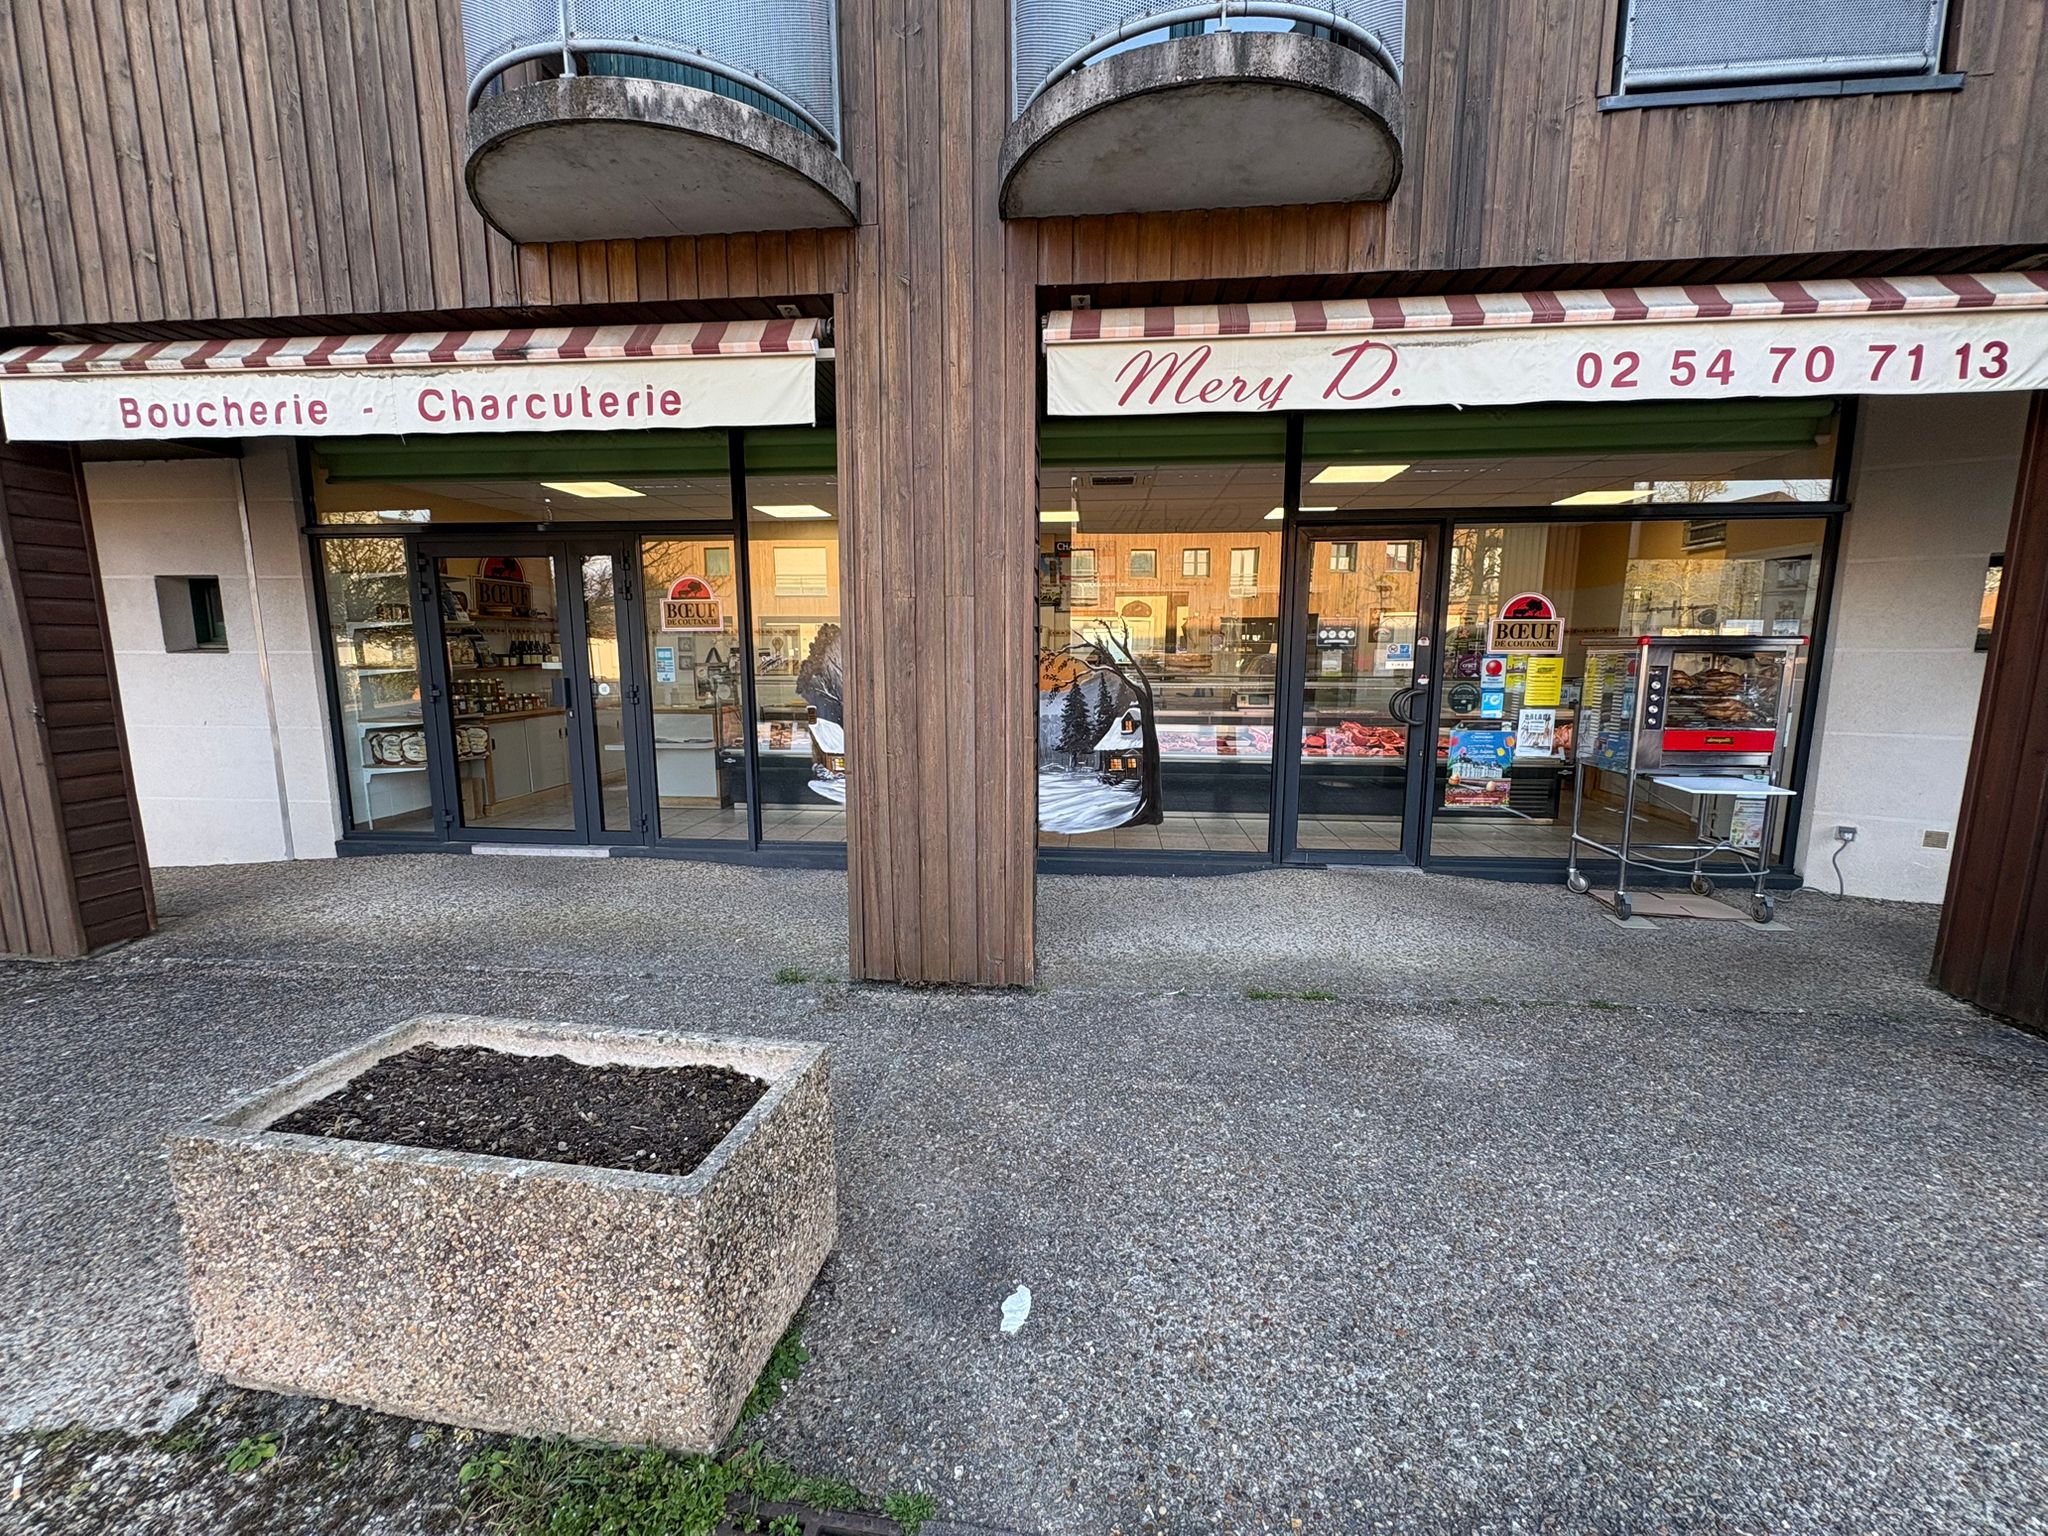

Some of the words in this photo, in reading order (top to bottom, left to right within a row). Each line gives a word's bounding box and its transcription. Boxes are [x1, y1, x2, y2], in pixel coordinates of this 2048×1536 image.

[1115, 345, 1292, 411] Mery
[1323, 340, 1401, 400] D.
[1576, 352, 1640, 389] 02
[1669, 349, 1735, 387] 54
[1768, 345, 1835, 384] 70
[1868, 344, 1925, 382] 71
[1955, 341, 2009, 380] 13
[119, 394, 328, 429] Boucherie
[418, 384, 682, 422] Charcuterie
[666, 602, 718, 619] BŒUF
[1494, 640, 1506, 648] DE
[1507, 640, 1557, 648] COUTANCIE
[1495, 623, 1558, 640] BŒUF
